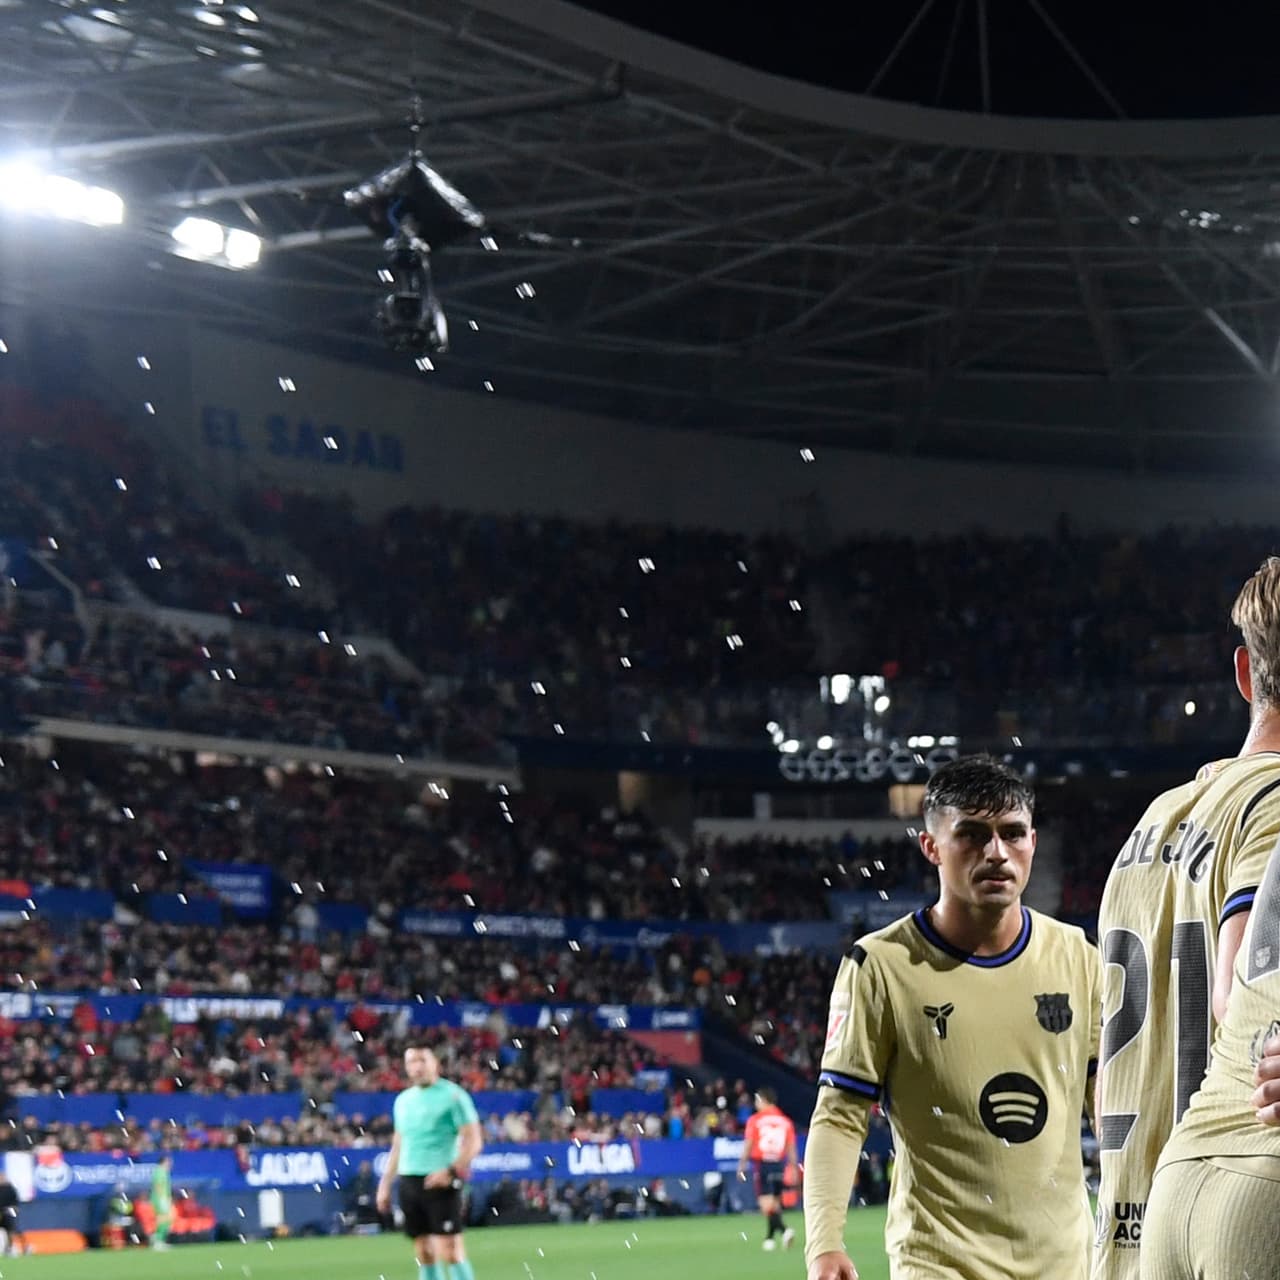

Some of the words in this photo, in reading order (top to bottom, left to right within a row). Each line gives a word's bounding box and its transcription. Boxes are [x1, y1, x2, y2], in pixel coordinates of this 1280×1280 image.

[1117, 824, 1160, 870] DE
[1101, 920, 1212, 1152] 21
[568, 1142, 636, 1175] LALIGA
